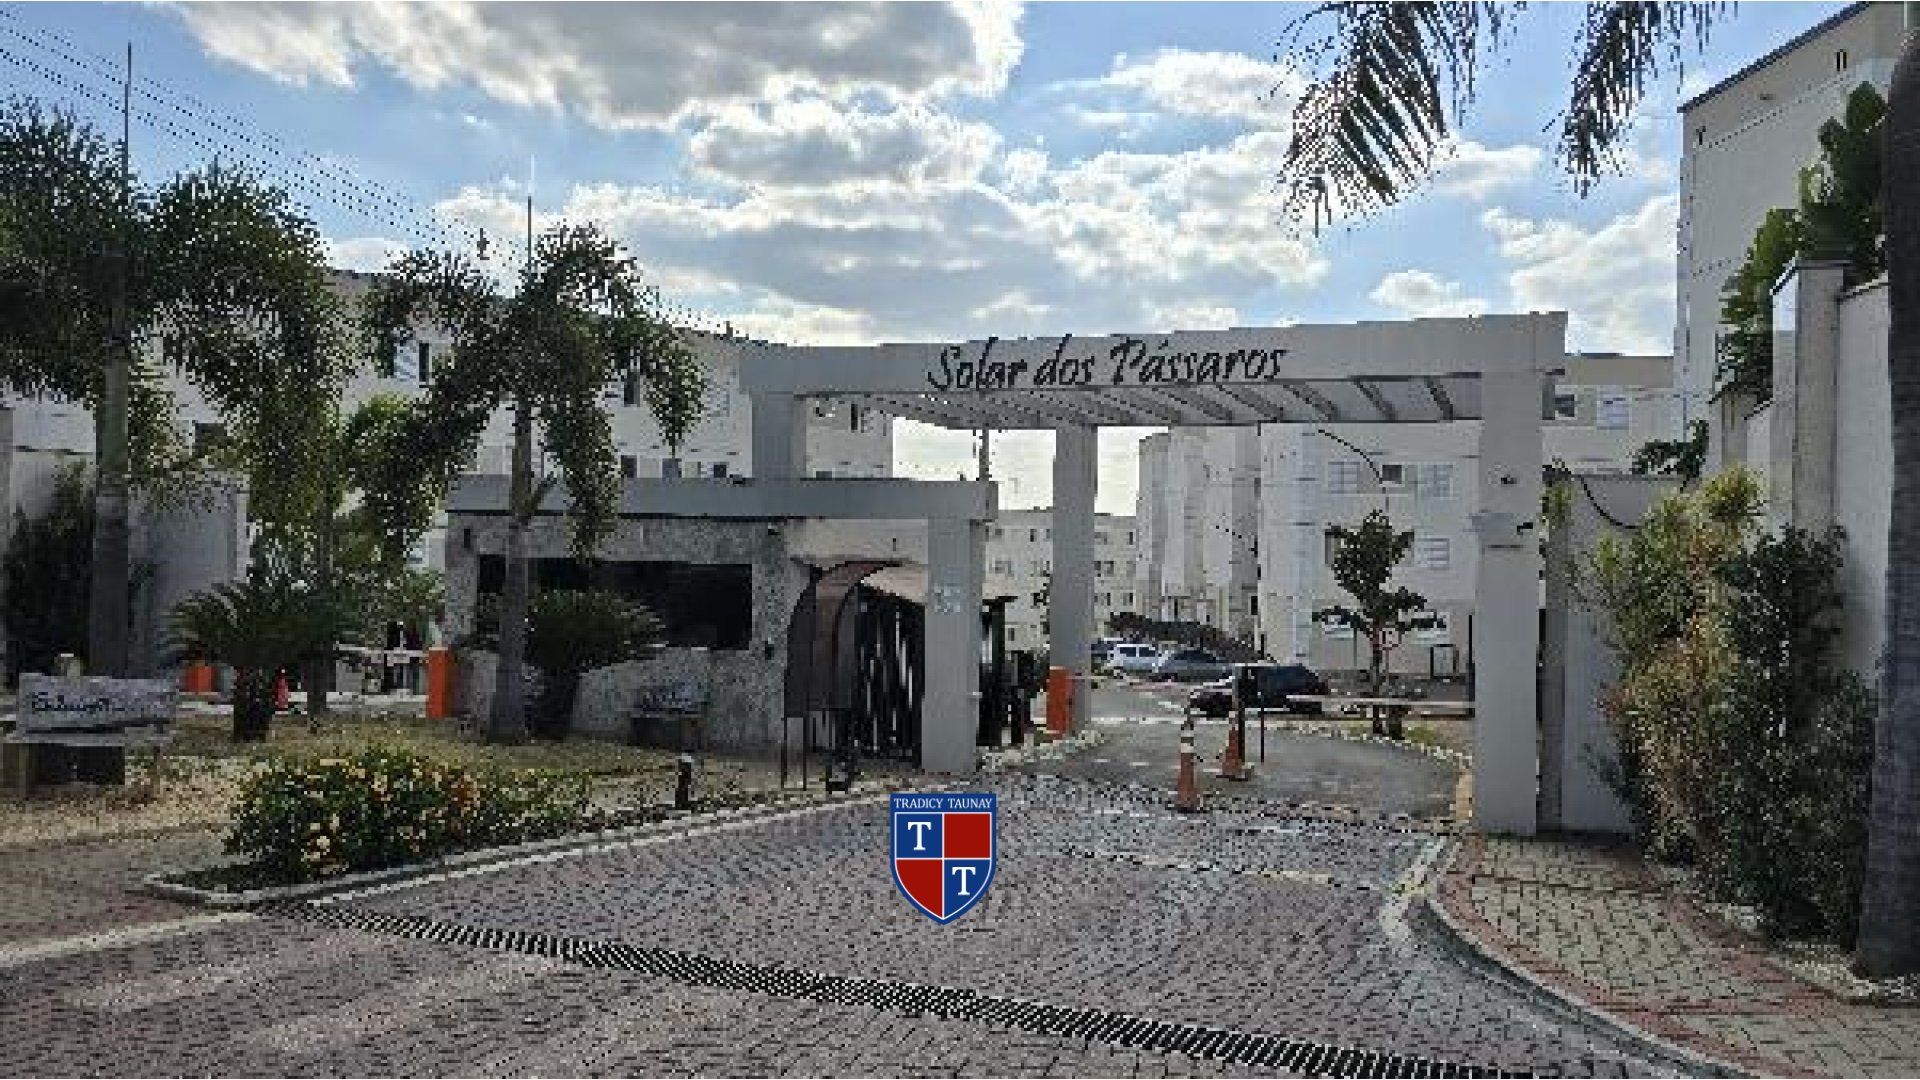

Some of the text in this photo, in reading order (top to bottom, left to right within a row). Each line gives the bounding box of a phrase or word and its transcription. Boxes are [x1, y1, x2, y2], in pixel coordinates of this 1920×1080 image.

[927, 333, 1289, 391] Solar dos Pássaros
